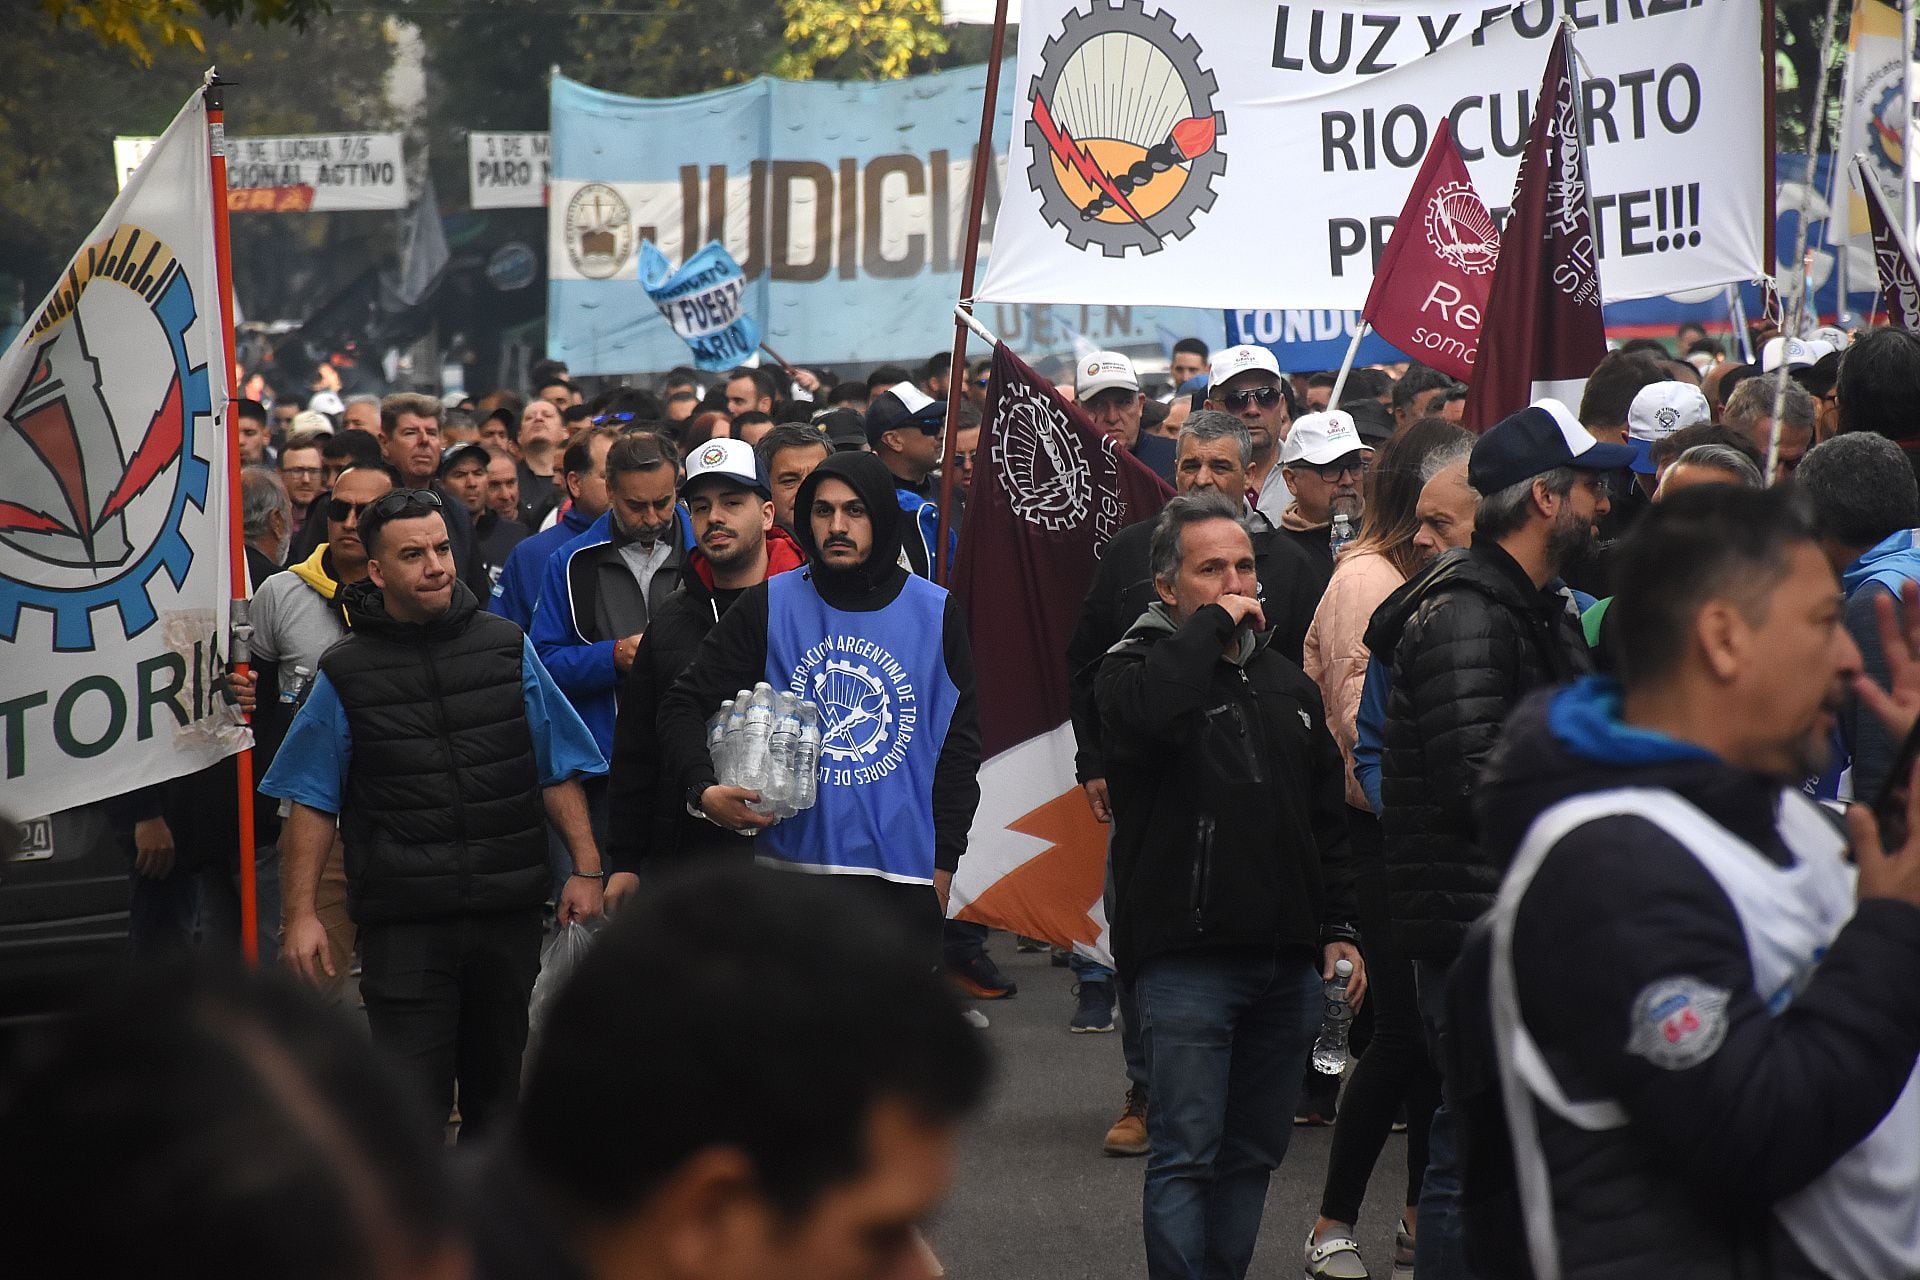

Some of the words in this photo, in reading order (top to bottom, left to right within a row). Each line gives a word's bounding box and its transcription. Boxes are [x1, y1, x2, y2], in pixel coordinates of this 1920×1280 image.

[1272, 3, 1401, 75] LUZ
[1417, 13, 1461, 57] Y
[1321, 103, 1428, 172] RIO
[1448, 62, 1702, 162] CURTO
[317, 161, 395, 187] ACTIVO
[477, 160, 530, 188] PARO
[638, 140, 1004, 284] JUDICIA
[679, 278, 745, 334] FUERZ
[1420, 279, 1481, 335] Re
[1573, 271, 1598, 307] SINDIC
[789, 634, 834, 700] EDERACION
[836, 634, 907, 686] ARGENTINA
[0, 630, 240, 780] TORIA
[895, 683, 916, 704] DE
[853, 706, 917, 785] TRABAJADORES
[833, 769, 851, 786] DE
